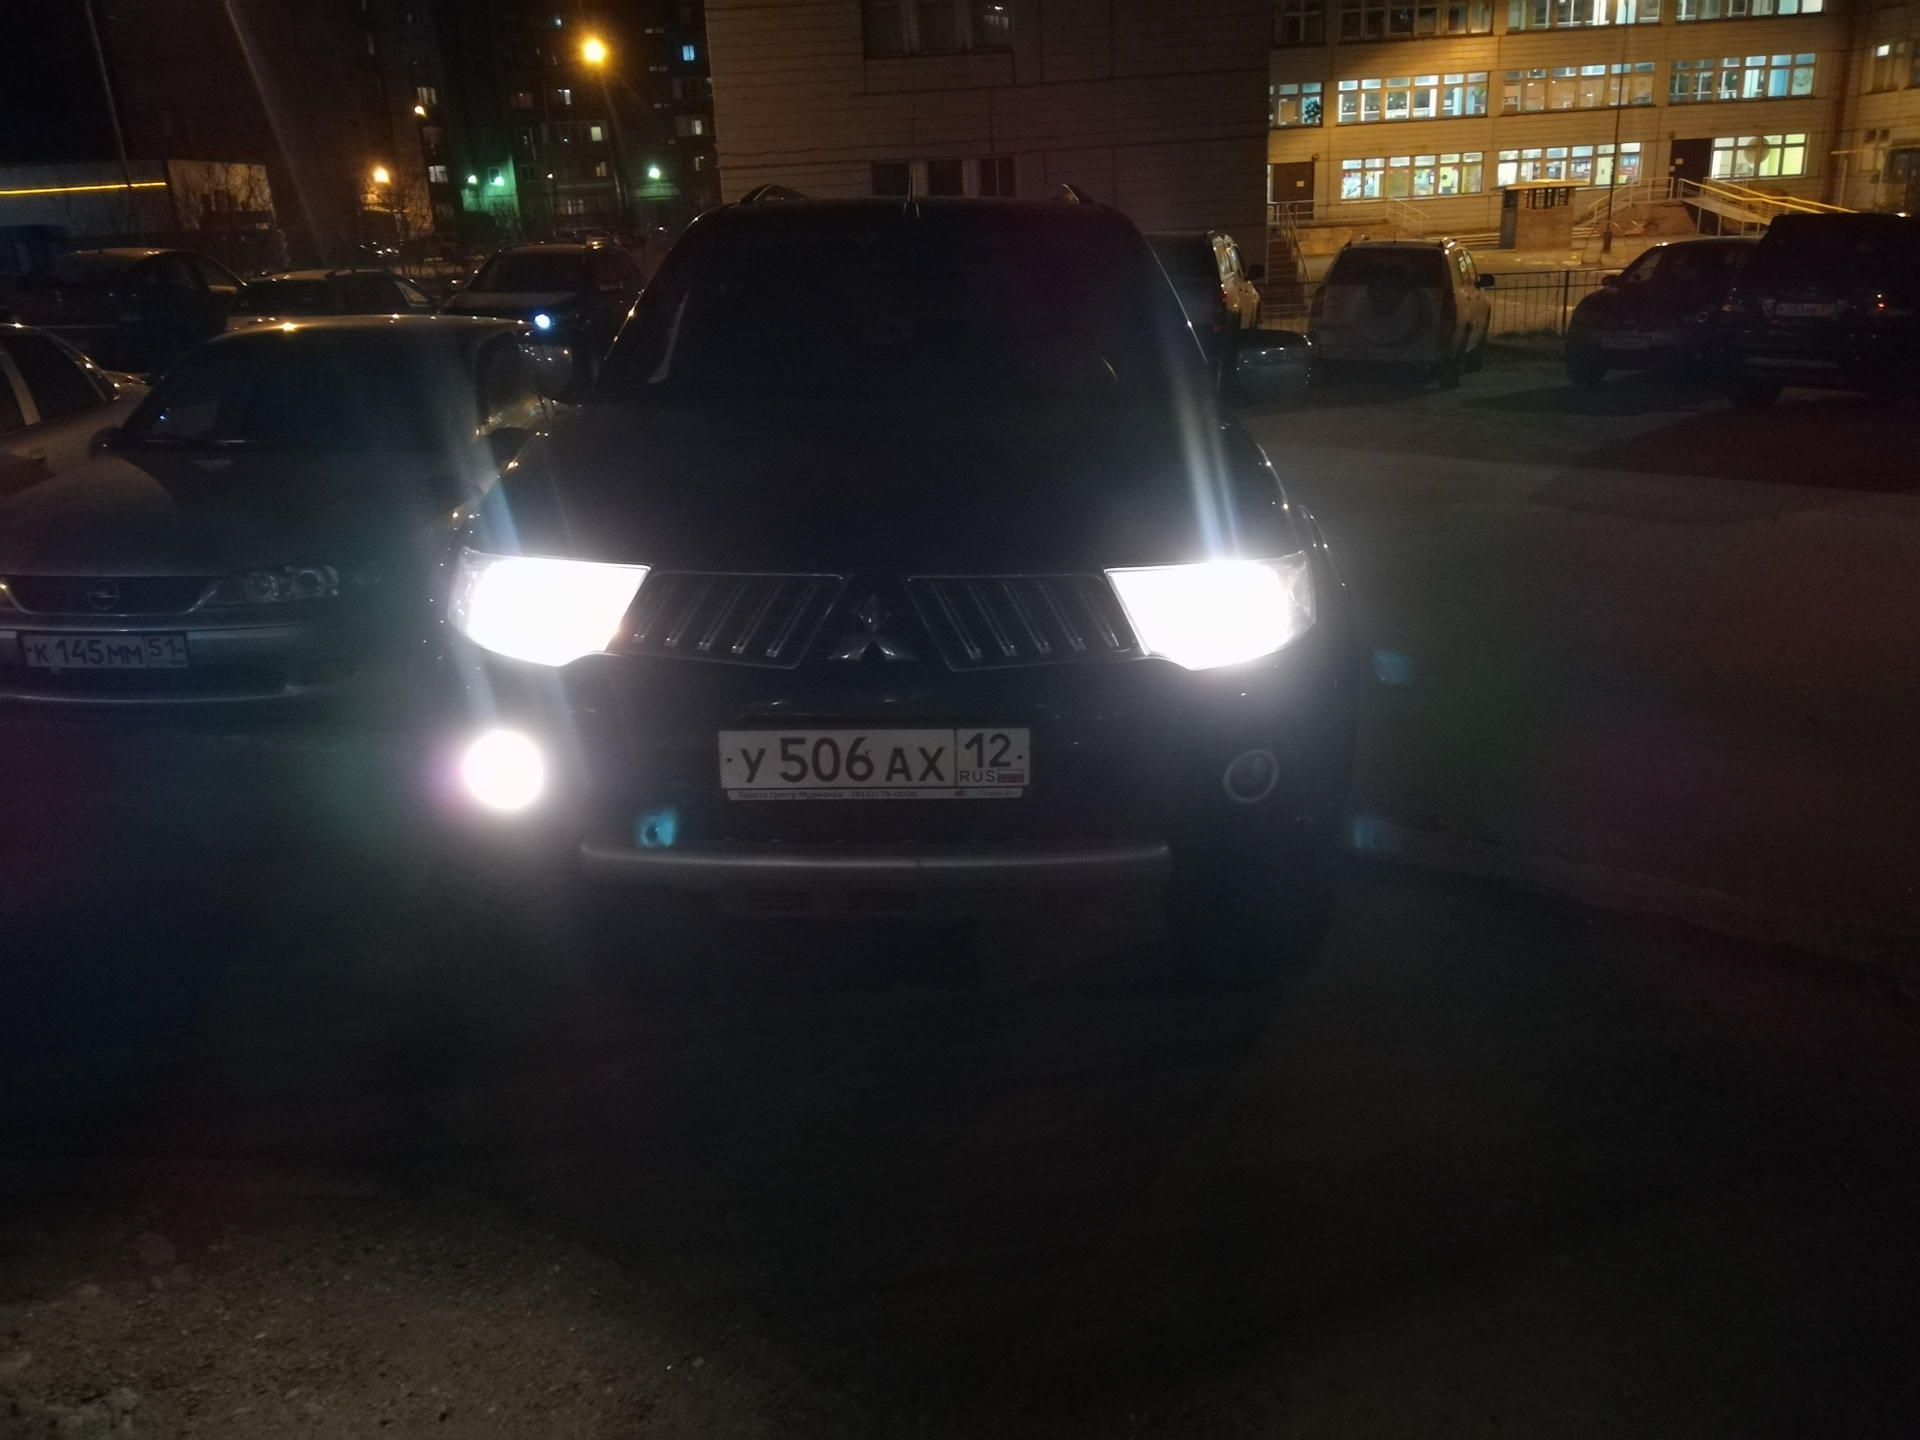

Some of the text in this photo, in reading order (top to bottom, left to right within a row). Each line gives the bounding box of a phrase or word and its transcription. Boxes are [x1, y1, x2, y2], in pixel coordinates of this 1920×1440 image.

[964, 733, 1012, 768] 12
[960, 770, 996, 783] RUS
[770, 791, 797, 800] Центр
[799, 791, 843, 800] Мурманск
